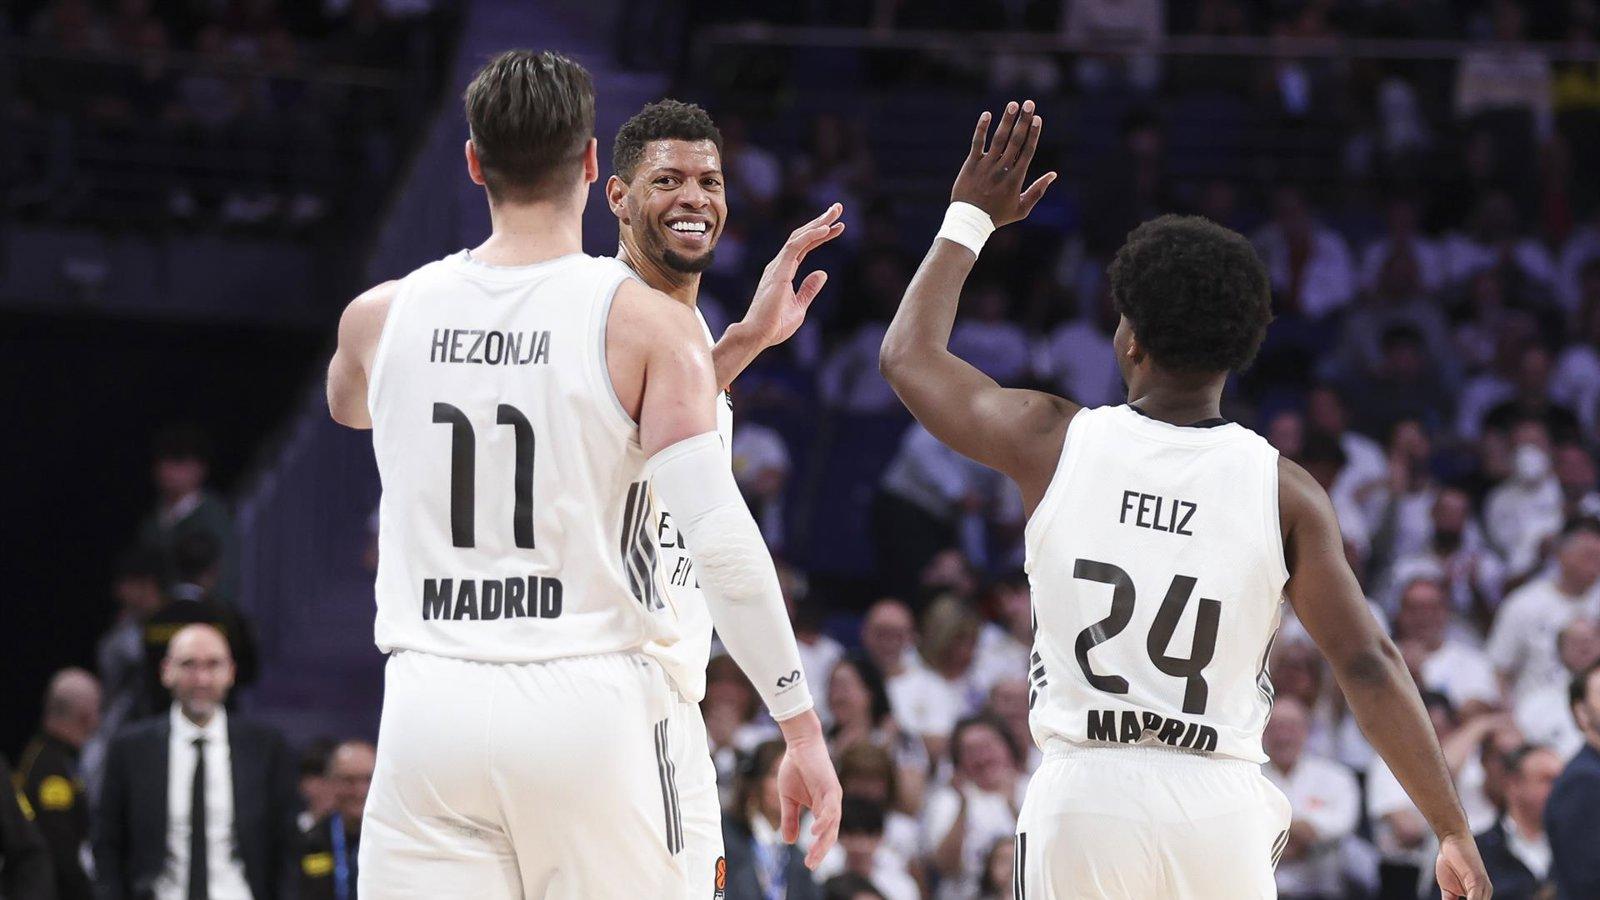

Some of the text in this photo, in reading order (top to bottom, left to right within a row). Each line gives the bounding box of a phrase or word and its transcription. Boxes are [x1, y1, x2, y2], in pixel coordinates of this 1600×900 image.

[430, 328, 551, 366] HEZONJA
[432, 402, 535, 549] 11
[1119, 490, 1198, 536] FELIZ
[422, 575, 563, 620] MADRID
[1073, 558, 1222, 715] 24
[1087, 709, 1219, 752] MADRID
